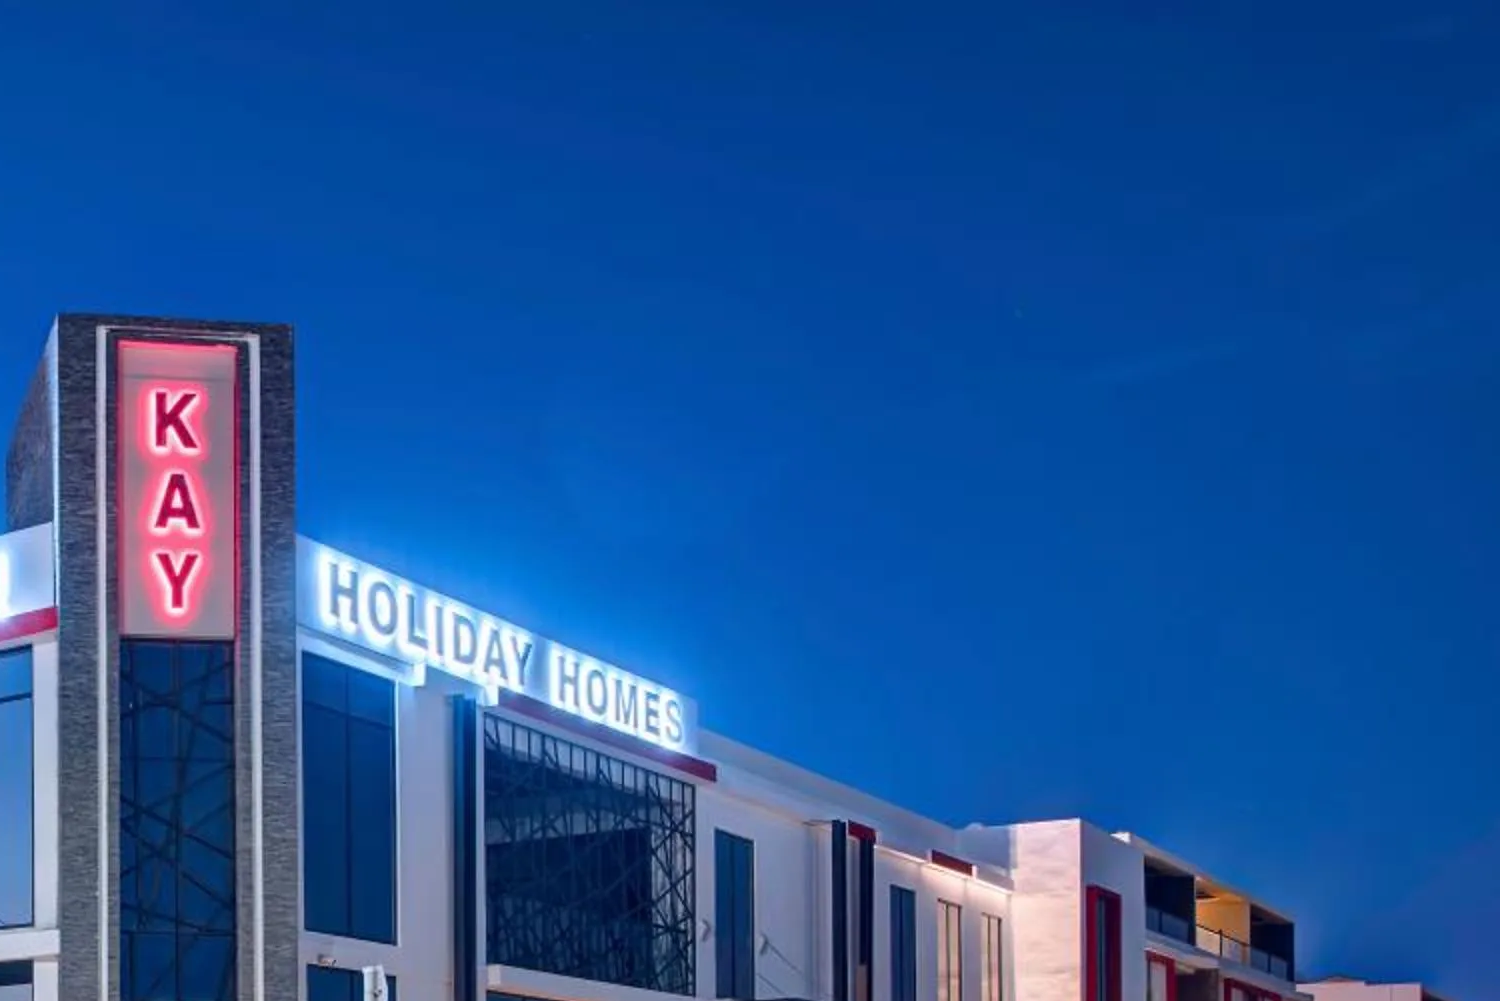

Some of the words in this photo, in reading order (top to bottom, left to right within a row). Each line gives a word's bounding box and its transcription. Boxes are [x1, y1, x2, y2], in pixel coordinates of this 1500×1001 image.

[154, 390, 201, 610] KAY
[328, 562, 532, 687] HOLIDAY
[557, 652, 682, 744] HOMES
